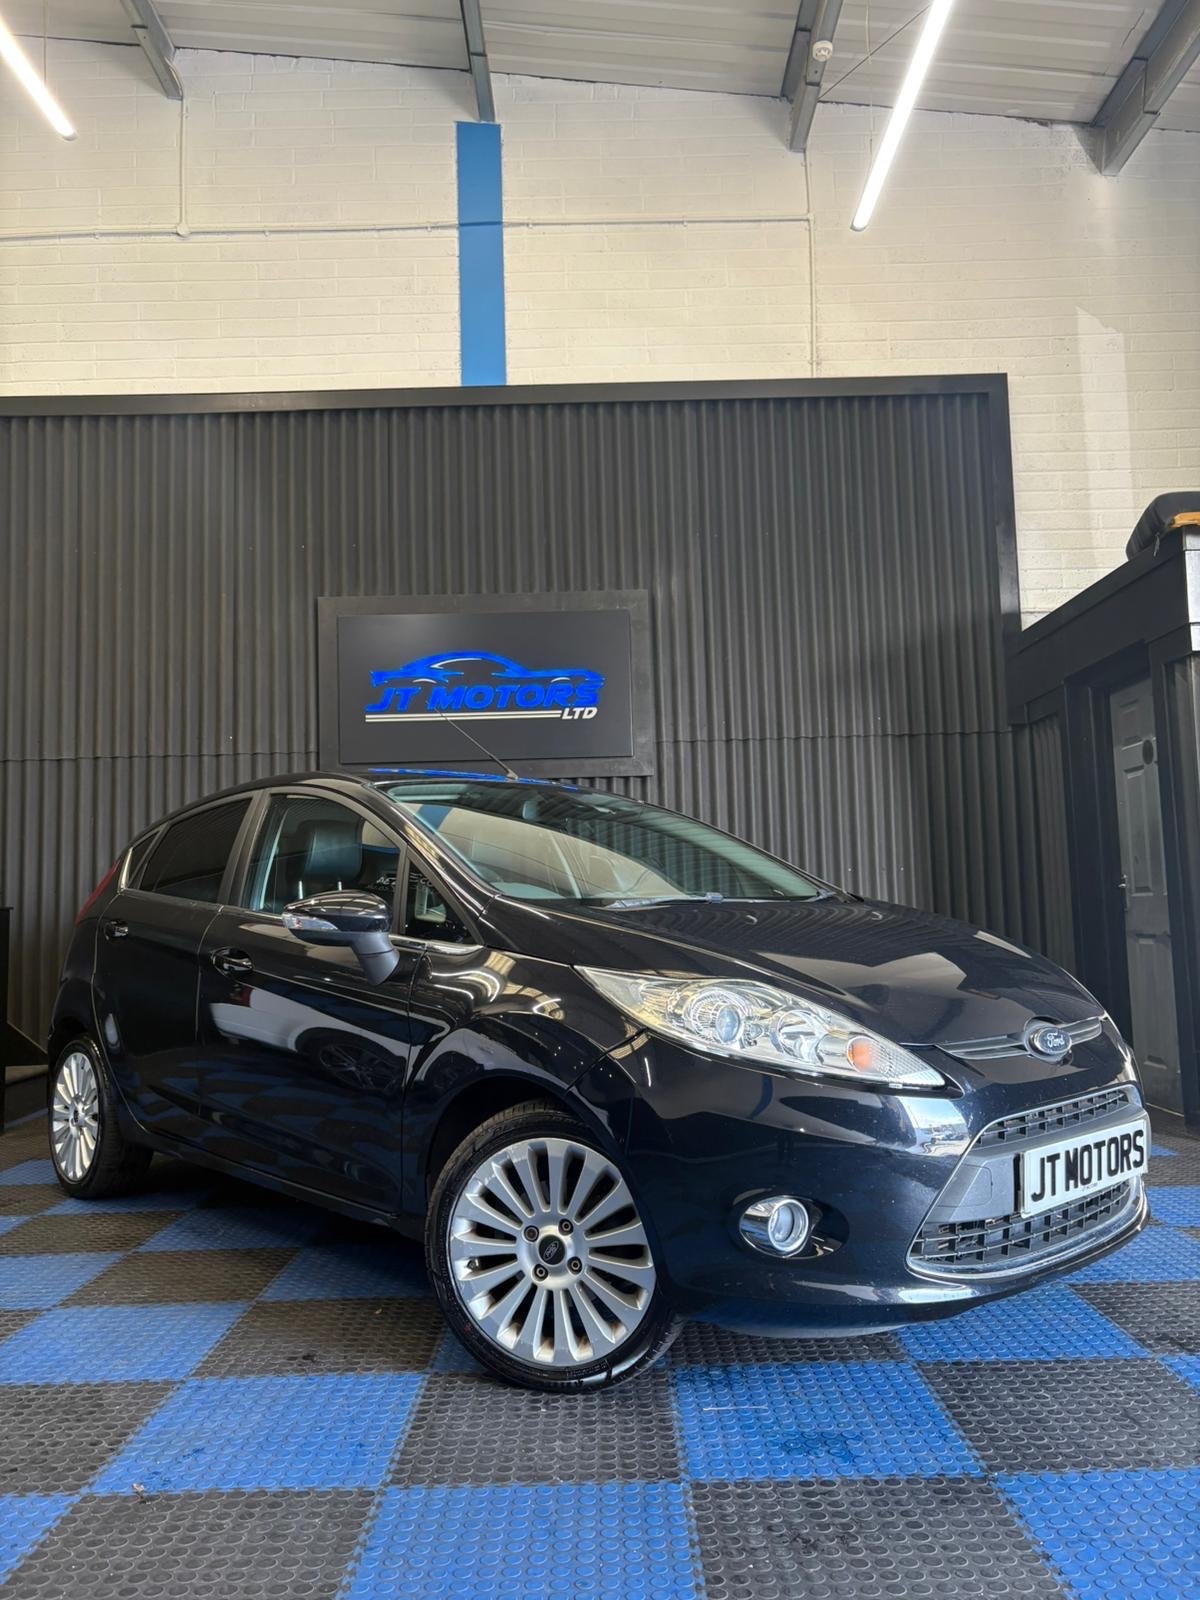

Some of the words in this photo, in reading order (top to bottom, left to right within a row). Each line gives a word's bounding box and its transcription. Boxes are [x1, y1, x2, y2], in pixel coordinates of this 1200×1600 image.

[365, 687, 421, 712] JT
[427, 683, 601, 709] MOTORS
[561, 706, 598, 720] LTD
[1046, 1032, 1065, 1048] Ford
[1031, 1153, 1061, 1202] JT
[1064, 1129, 1144, 1192] MOTORS
